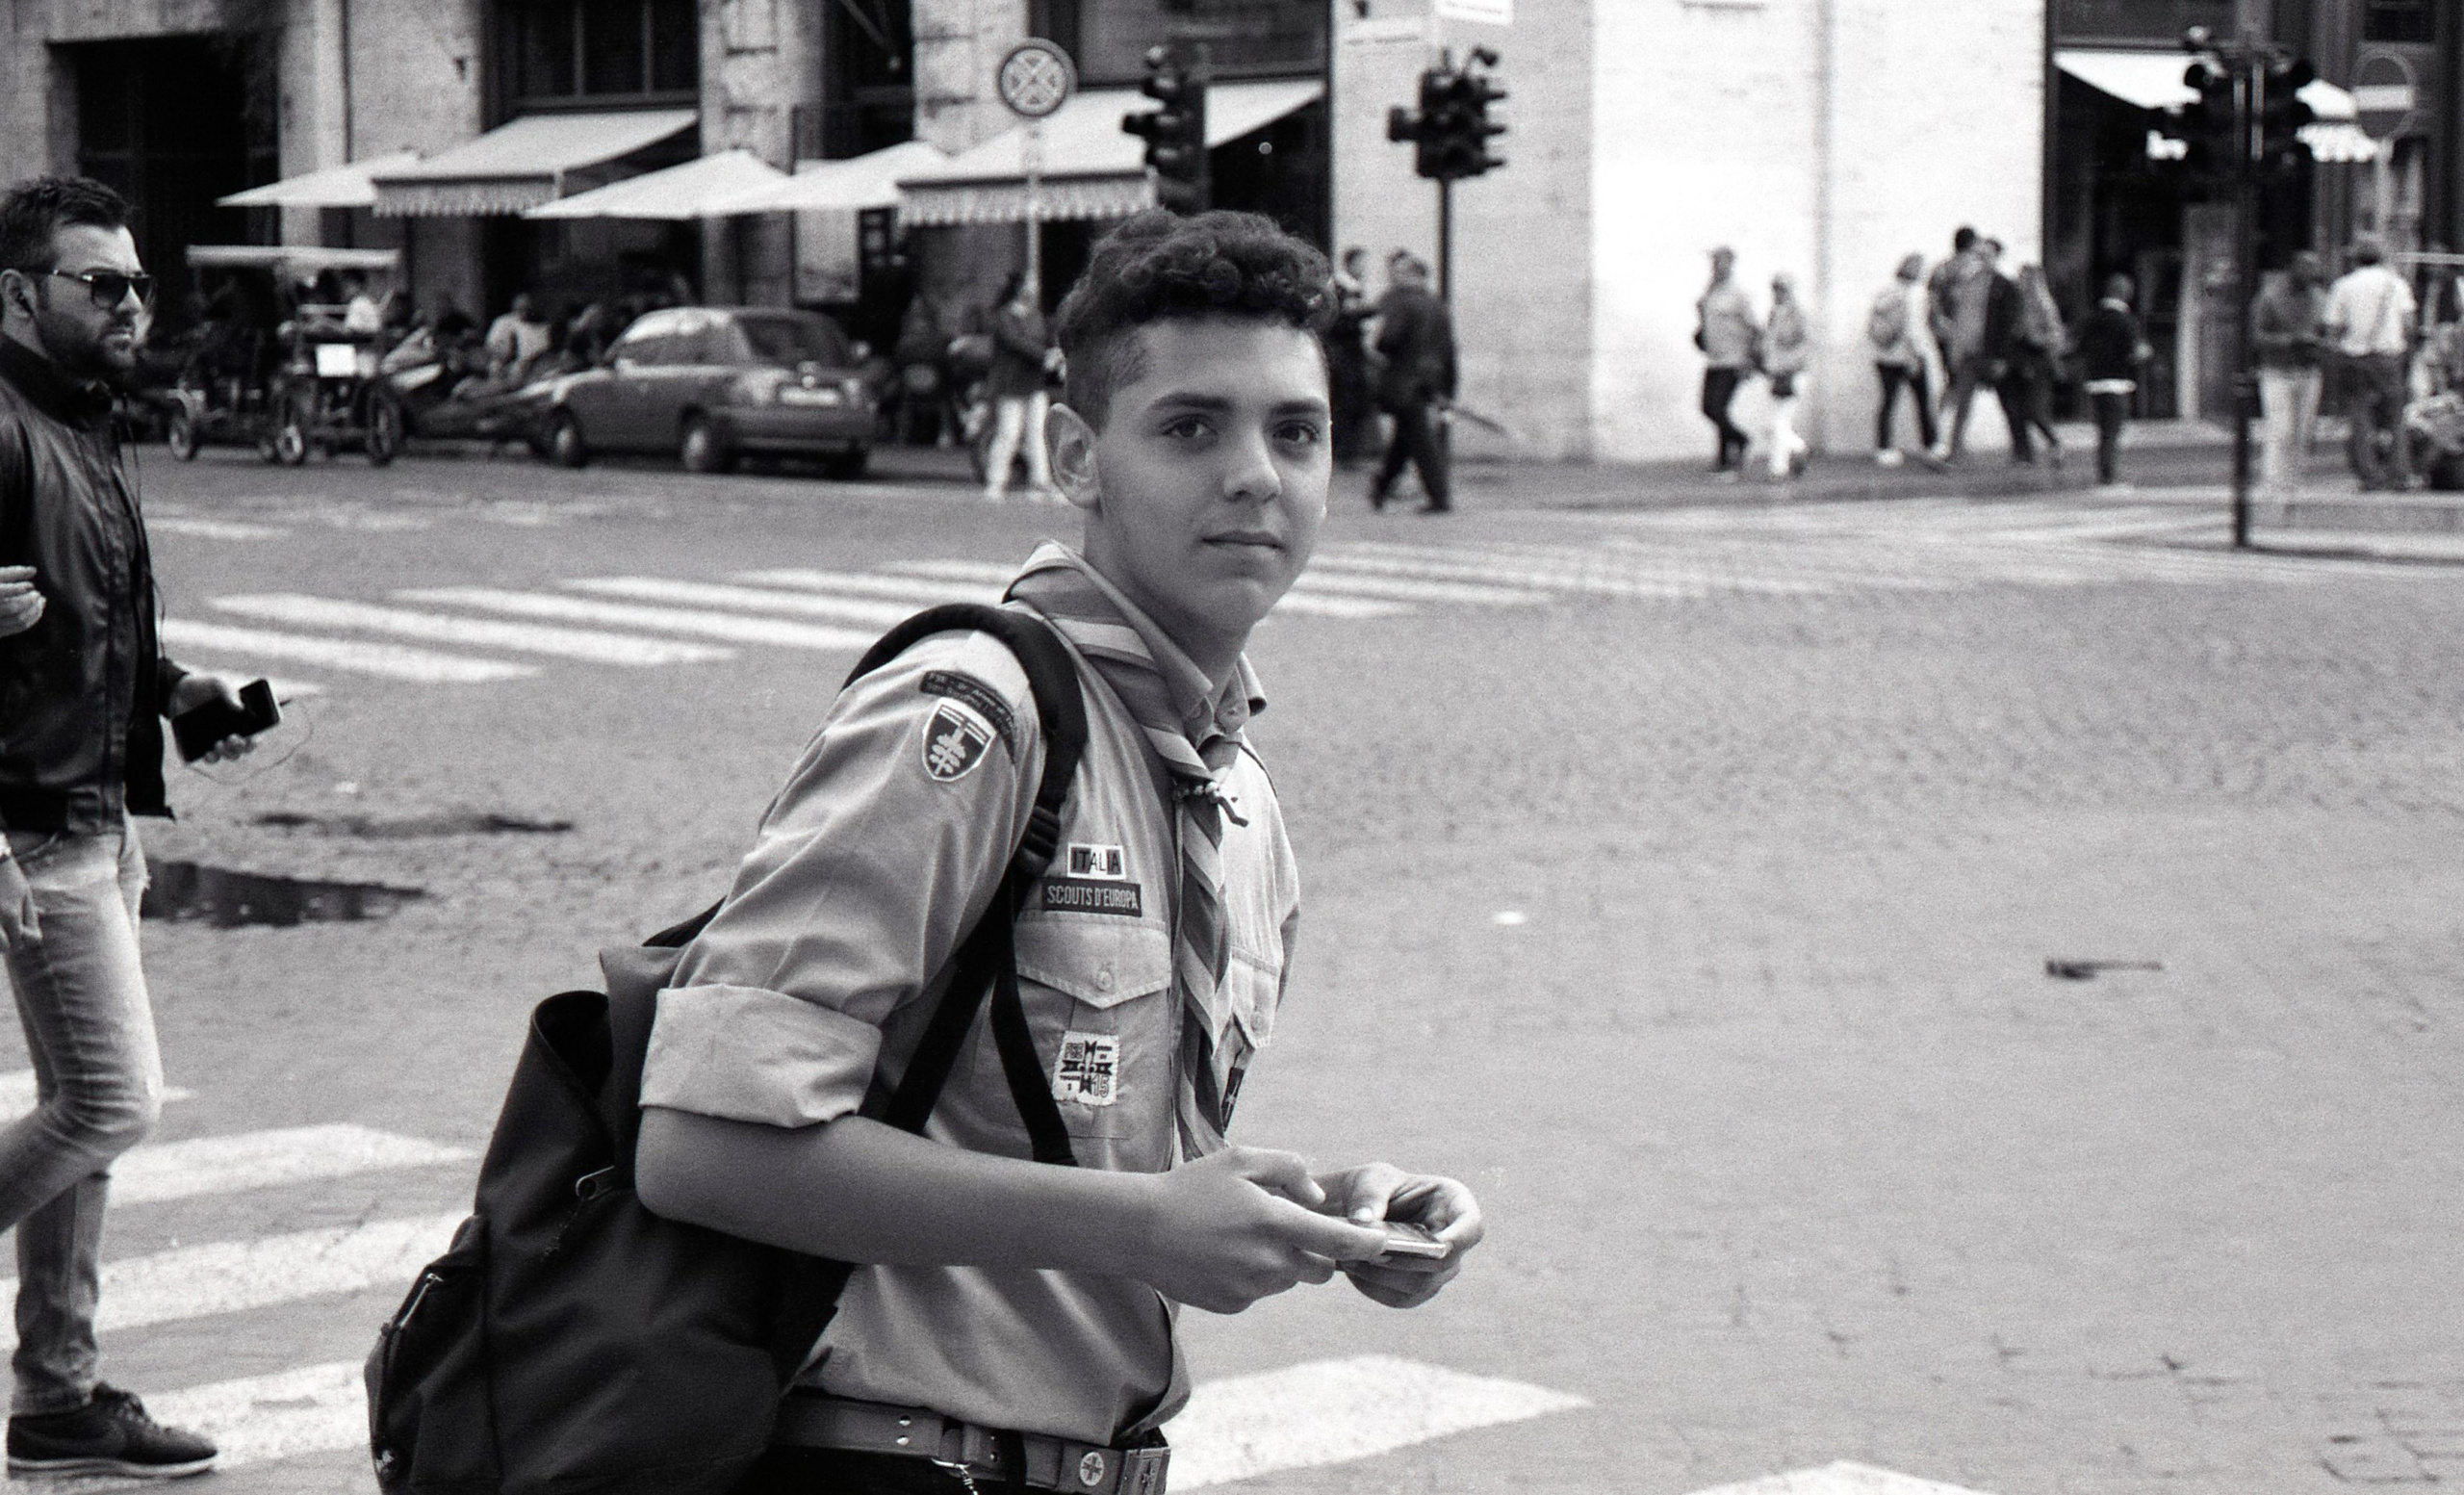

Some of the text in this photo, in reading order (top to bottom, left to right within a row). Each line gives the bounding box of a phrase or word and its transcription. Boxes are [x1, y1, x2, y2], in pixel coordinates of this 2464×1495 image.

[1071, 850, 1121, 873] ITALIA
[1047, 885, 1139, 909] SCOUTS D'EUROPA
[1091, 1073, 1110, 1098] 15
